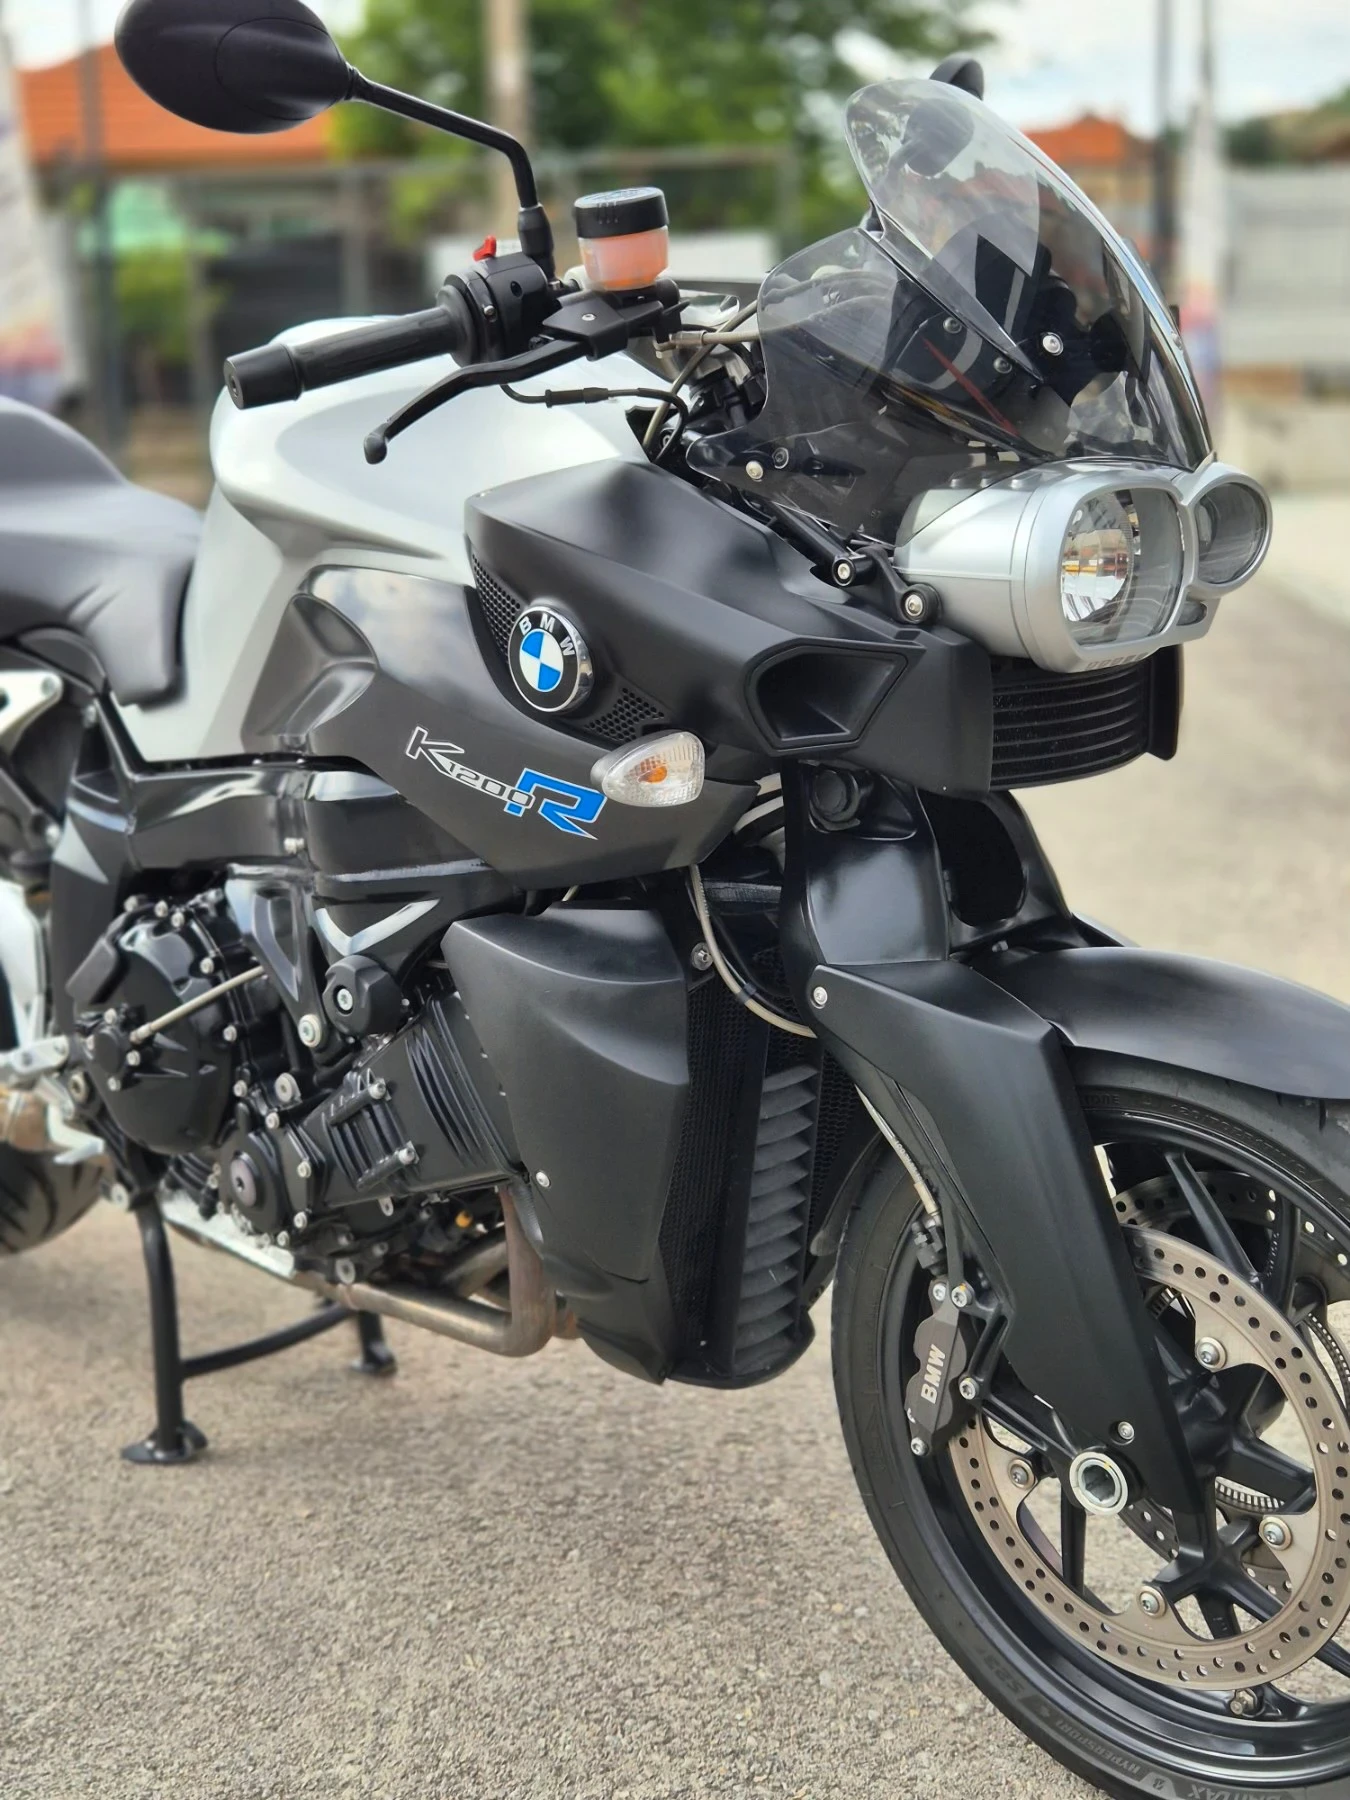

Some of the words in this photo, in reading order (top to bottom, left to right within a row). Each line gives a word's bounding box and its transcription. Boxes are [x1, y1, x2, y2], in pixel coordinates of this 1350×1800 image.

[519, 612, 575, 656] BMW
[920, 1343, 946, 1405] BMW
[1055, 1719, 1142, 1776] HYPERSPORT
